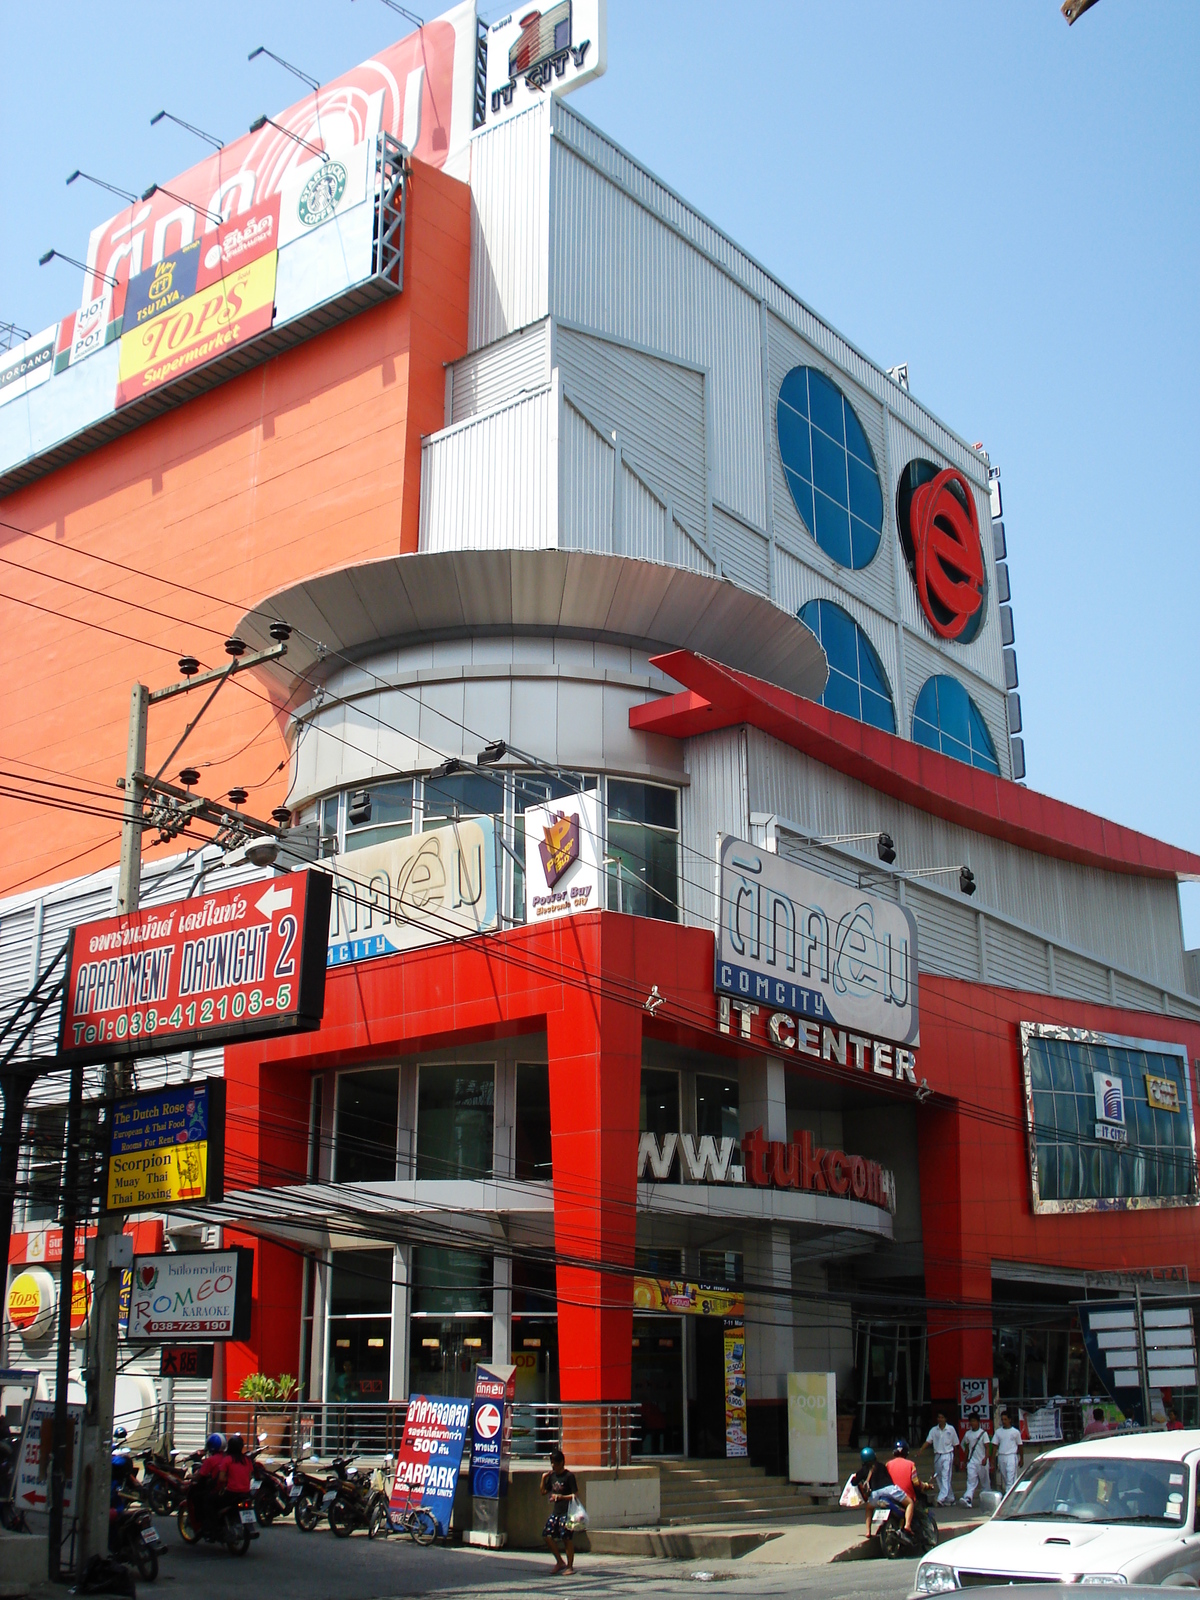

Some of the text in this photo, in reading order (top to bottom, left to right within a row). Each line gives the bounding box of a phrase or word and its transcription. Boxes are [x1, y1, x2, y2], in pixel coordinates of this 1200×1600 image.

[490, 38, 592, 113] IT CITY
[301, 163, 345, 203] STARBUCKS
[79, 297, 106, 322] HOT
[137, 289, 180, 322] TSUTAYA
[142, 279, 248, 365] TOPS
[75, 329, 101, 354] POT
[1, 349, 50, 384] IORDANO
[142, 324, 240, 387] Supermarket
[532, 884, 592, 908] Power Buy
[536, 897, 588, 916] Electronic City
[73, 913, 298, 1017] APARTMENT DAYNIGHT 2
[721, 966, 824, 1016] COMCITY
[72, 983, 292, 1045] Tel:038-412103-5
[719, 996, 917, 1083] IT CENTER
[114, 1102, 185, 1125] The Dutch Rose
[113, 1118, 186, 1140] European & Thai Food
[1102, 1125, 1126, 1141] IT CITY
[121, 1135, 175, 1152] Rooms For Rent
[114, 1153, 172, 1173] Scorpion
[115, 1171, 168, 1189] Muay Thai
[112, 1188, 172, 1205] Thai Boxing
[1161, 1266, 1186, 1282] TAI
[8, 1290, 39, 1306] TOPS
[134, 1274, 233, 1319] ROMEO
[182, 1305, 230, 1317] KARAOKE
[151, 1321, 227, 1331] 038-723 190
[962, 1381, 986, 1390] HOT
[407, 1400, 469, 1427] อาคารจอดรถ
[789, 1395, 826, 1409] FOOD
[963, 1404, 988, 1413] POT
[413, 1439, 438, 1453] 500
[438, 1443, 449, 1455] คัน
[397, 1461, 457, 1489] CARPARK
[394, 1482, 410, 1492] MORE
[426, 1487, 435, 1495] 500
[437, 1488, 453, 1497] UNITS
